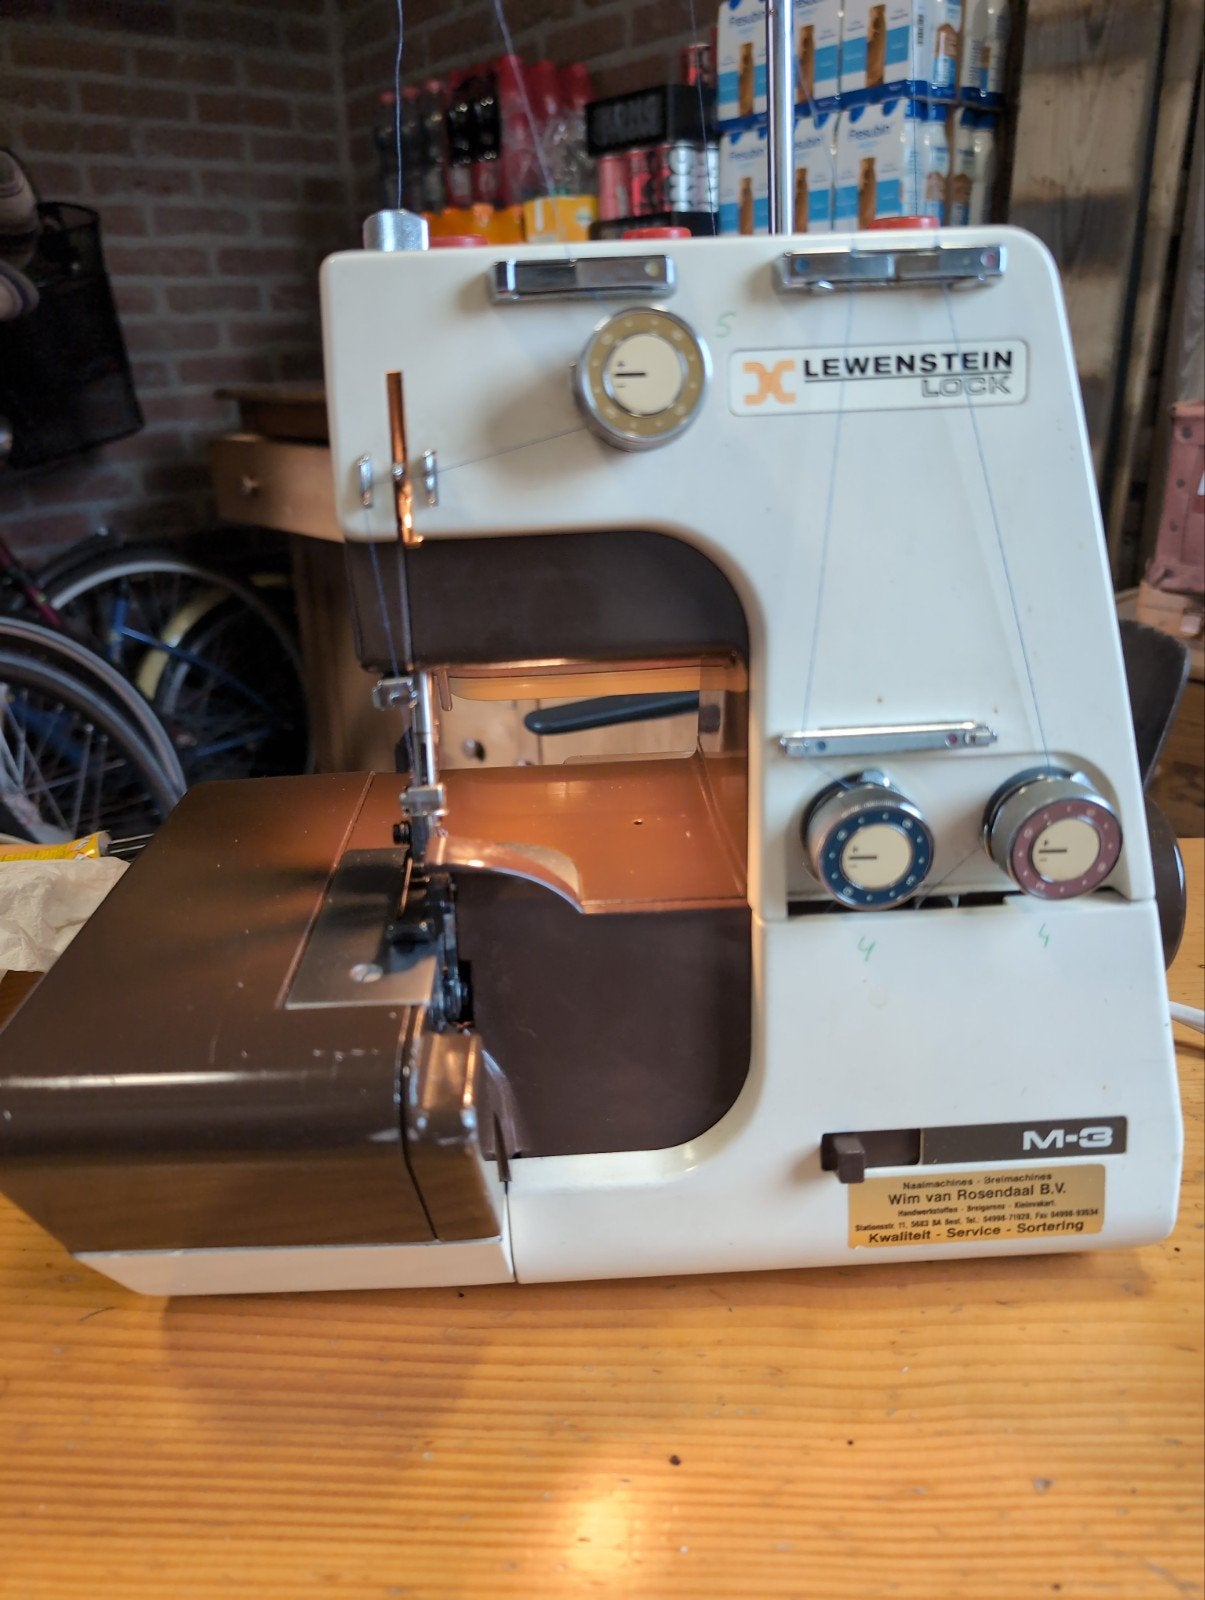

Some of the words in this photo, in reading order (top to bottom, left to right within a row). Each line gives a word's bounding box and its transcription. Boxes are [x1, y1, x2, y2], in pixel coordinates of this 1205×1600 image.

[803, 351, 1013, 378] LEWENSTEIN
[921, 376, 1012, 398] LOCK
[1022, 1125, 1113, 1151] M-3
[888, 1193, 920, 1205] Wim
[926, 1192, 951, 1203] van
[957, 1185, 1034, 1201] Rosendaal
[1040, 1182, 1066, 1195] B.V.
[868, 1230, 931, 1243] Kwaliteit
[946, 1226, 1001, 1239] Service
[1016, 1221, 1084, 1233] Sortering
